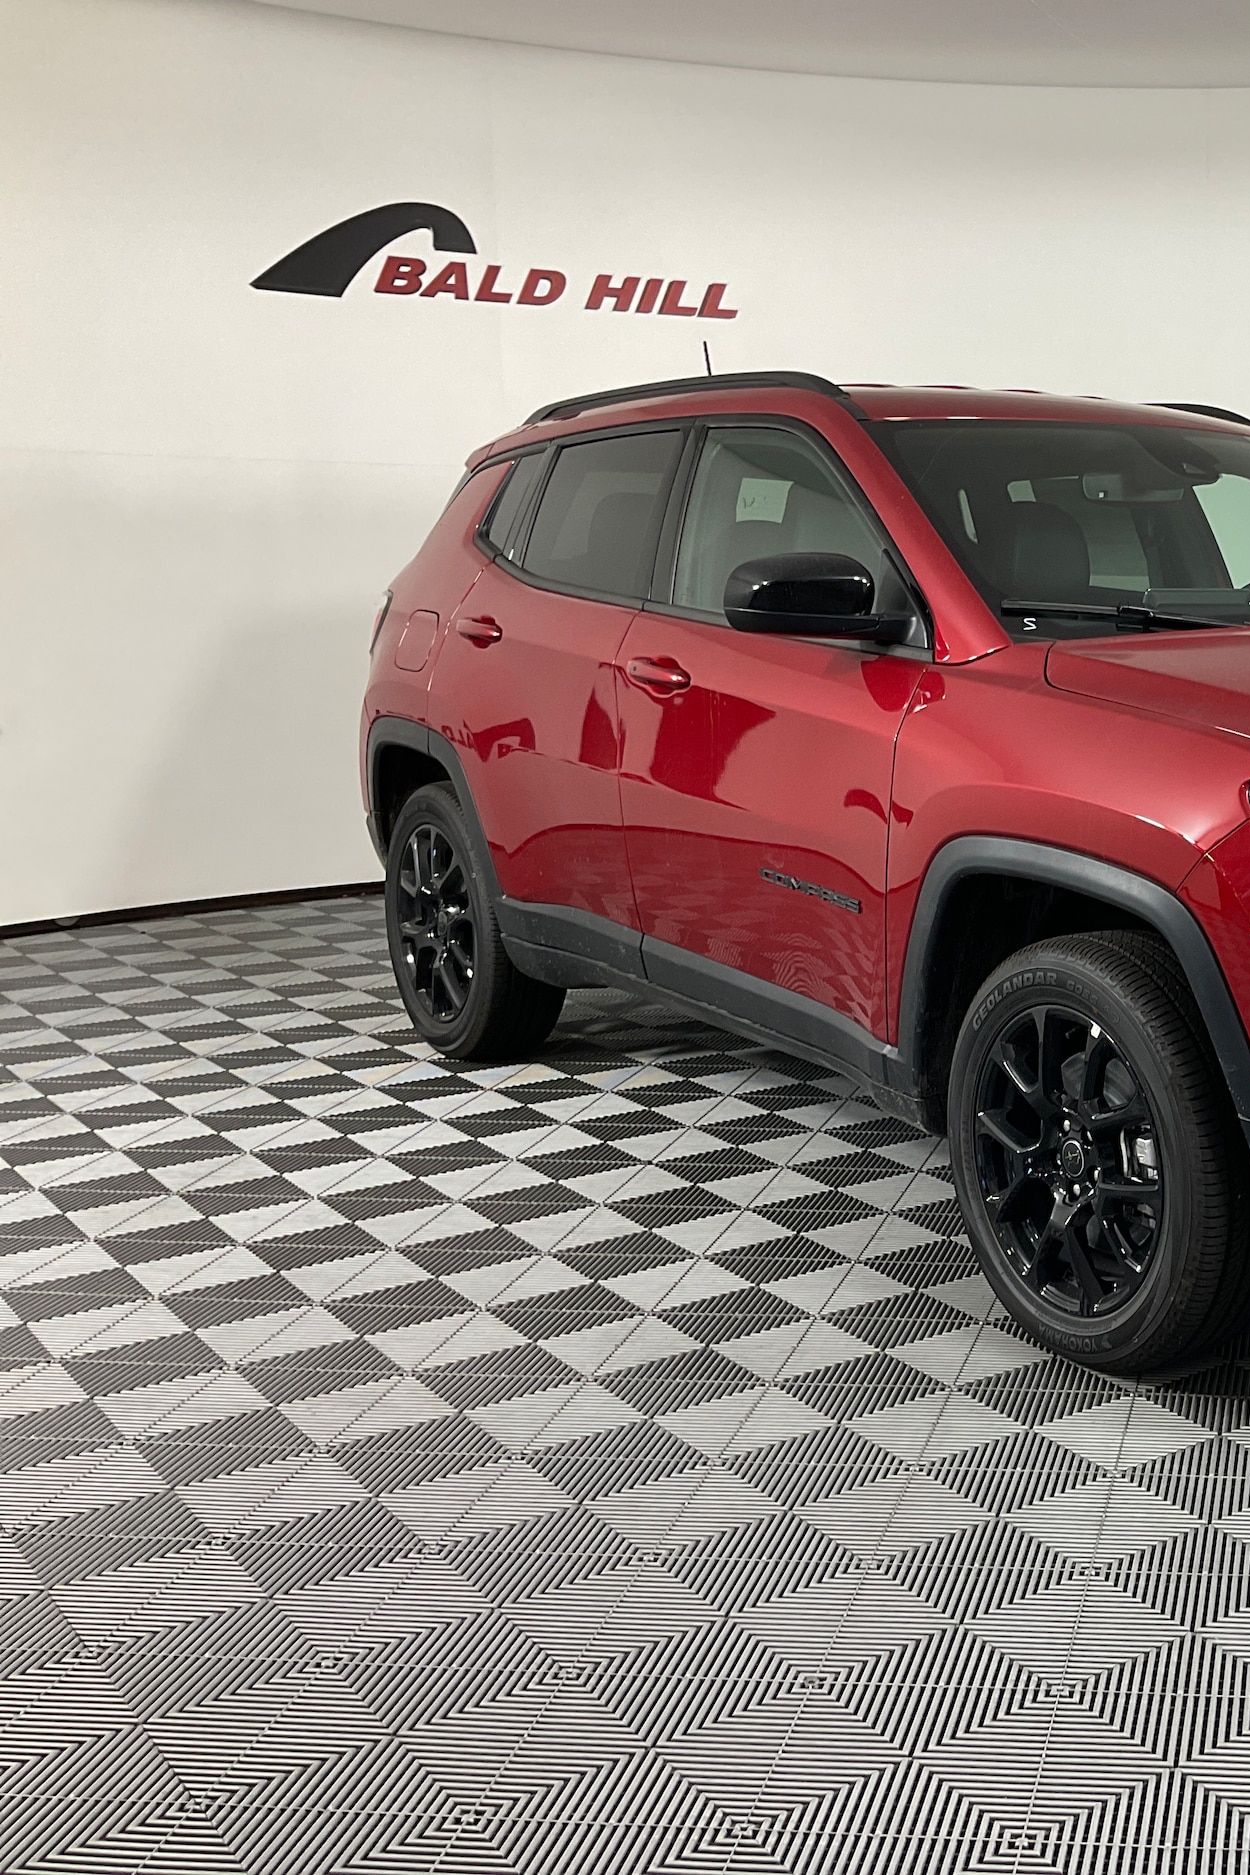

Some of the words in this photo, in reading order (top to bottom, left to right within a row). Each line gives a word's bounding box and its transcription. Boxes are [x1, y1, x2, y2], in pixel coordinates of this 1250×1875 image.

[374, 255, 567, 306] BALD
[584, 273, 738, 319] HILL
[759, 867, 862, 914] COMPASS
[972, 971, 1057, 1031] GEOLANDAR
[1037, 1322, 1098, 1353] YOKOHAMA
